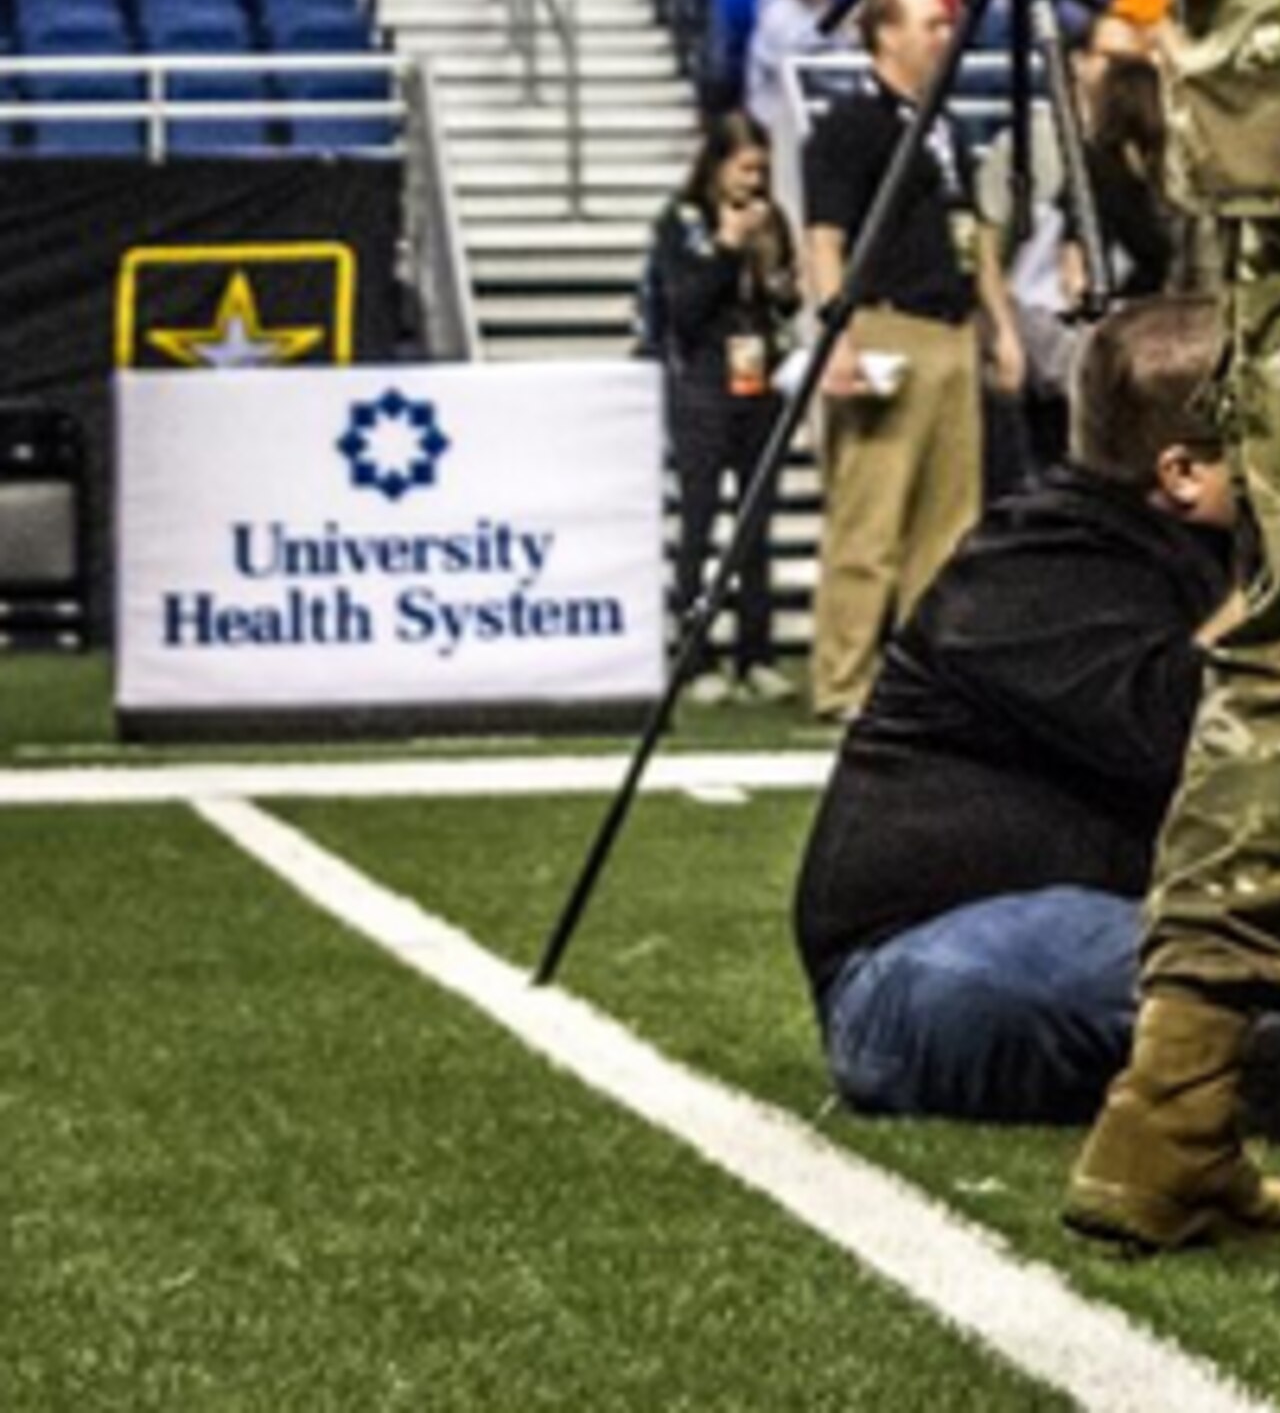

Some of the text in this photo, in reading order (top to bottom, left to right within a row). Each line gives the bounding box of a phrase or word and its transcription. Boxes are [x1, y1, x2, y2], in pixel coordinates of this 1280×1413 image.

[230, 519, 556, 586] University
[161, 586, 625, 656] Health System
